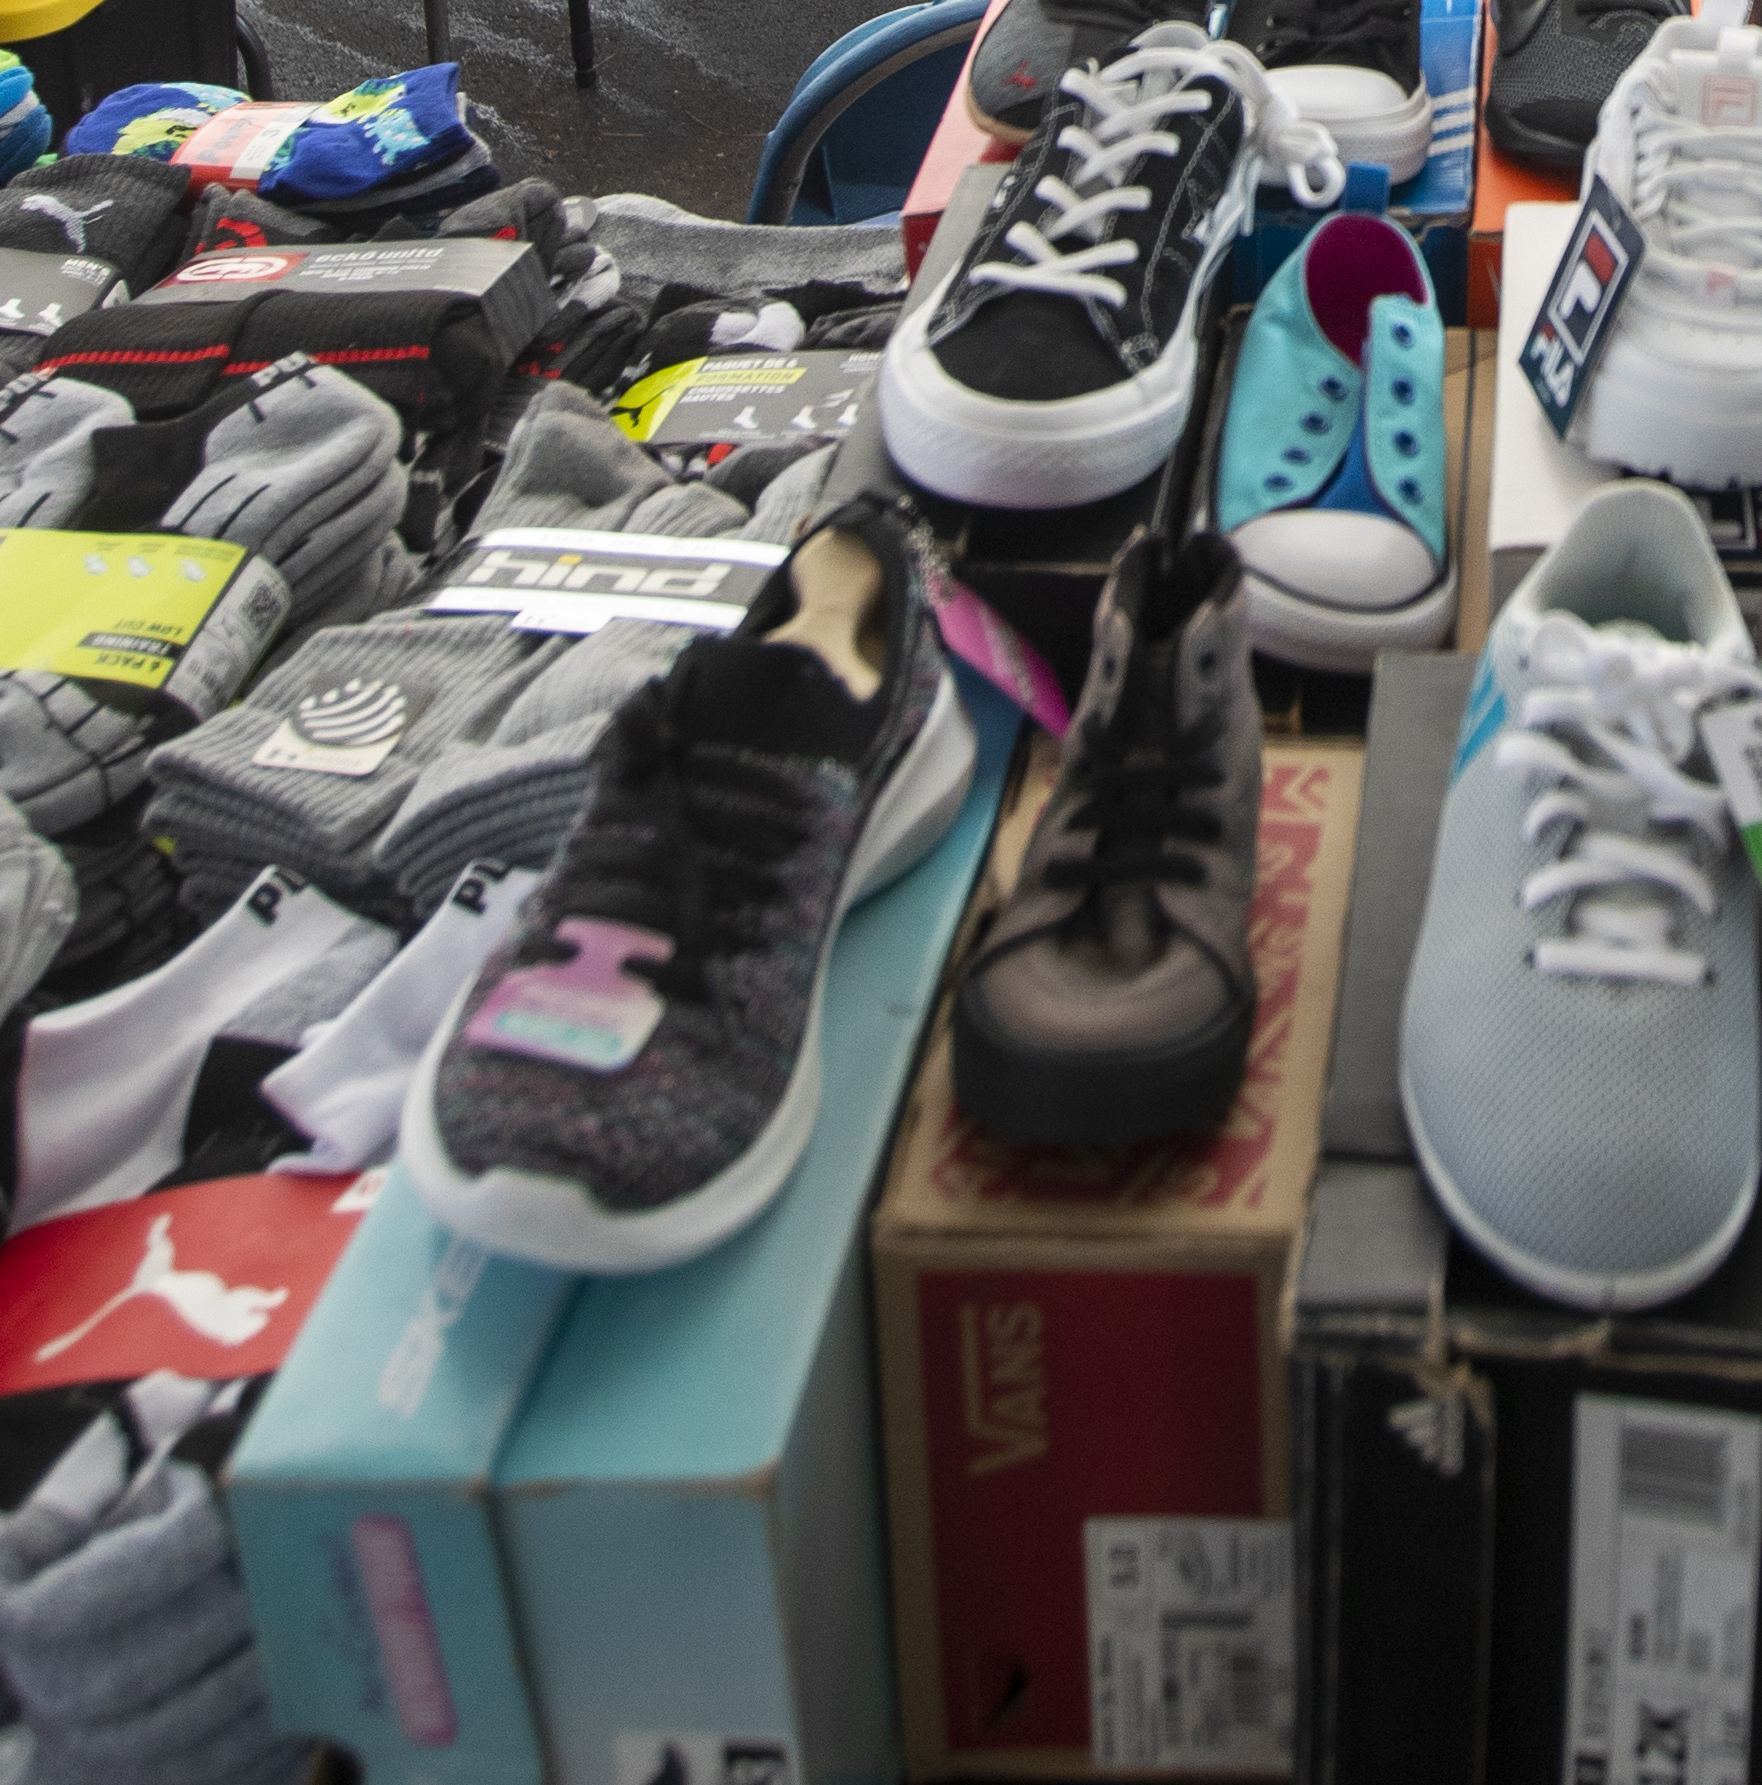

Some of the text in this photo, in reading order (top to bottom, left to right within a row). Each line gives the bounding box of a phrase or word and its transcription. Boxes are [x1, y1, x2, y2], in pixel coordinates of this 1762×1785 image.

[694, 372, 795, 384] FORMATION
[1530, 322, 1575, 408] FILA
[466, 549, 732, 597] hind
[94, 652, 148, 670] PACK
[960, 1302, 1046, 1477] VANS
